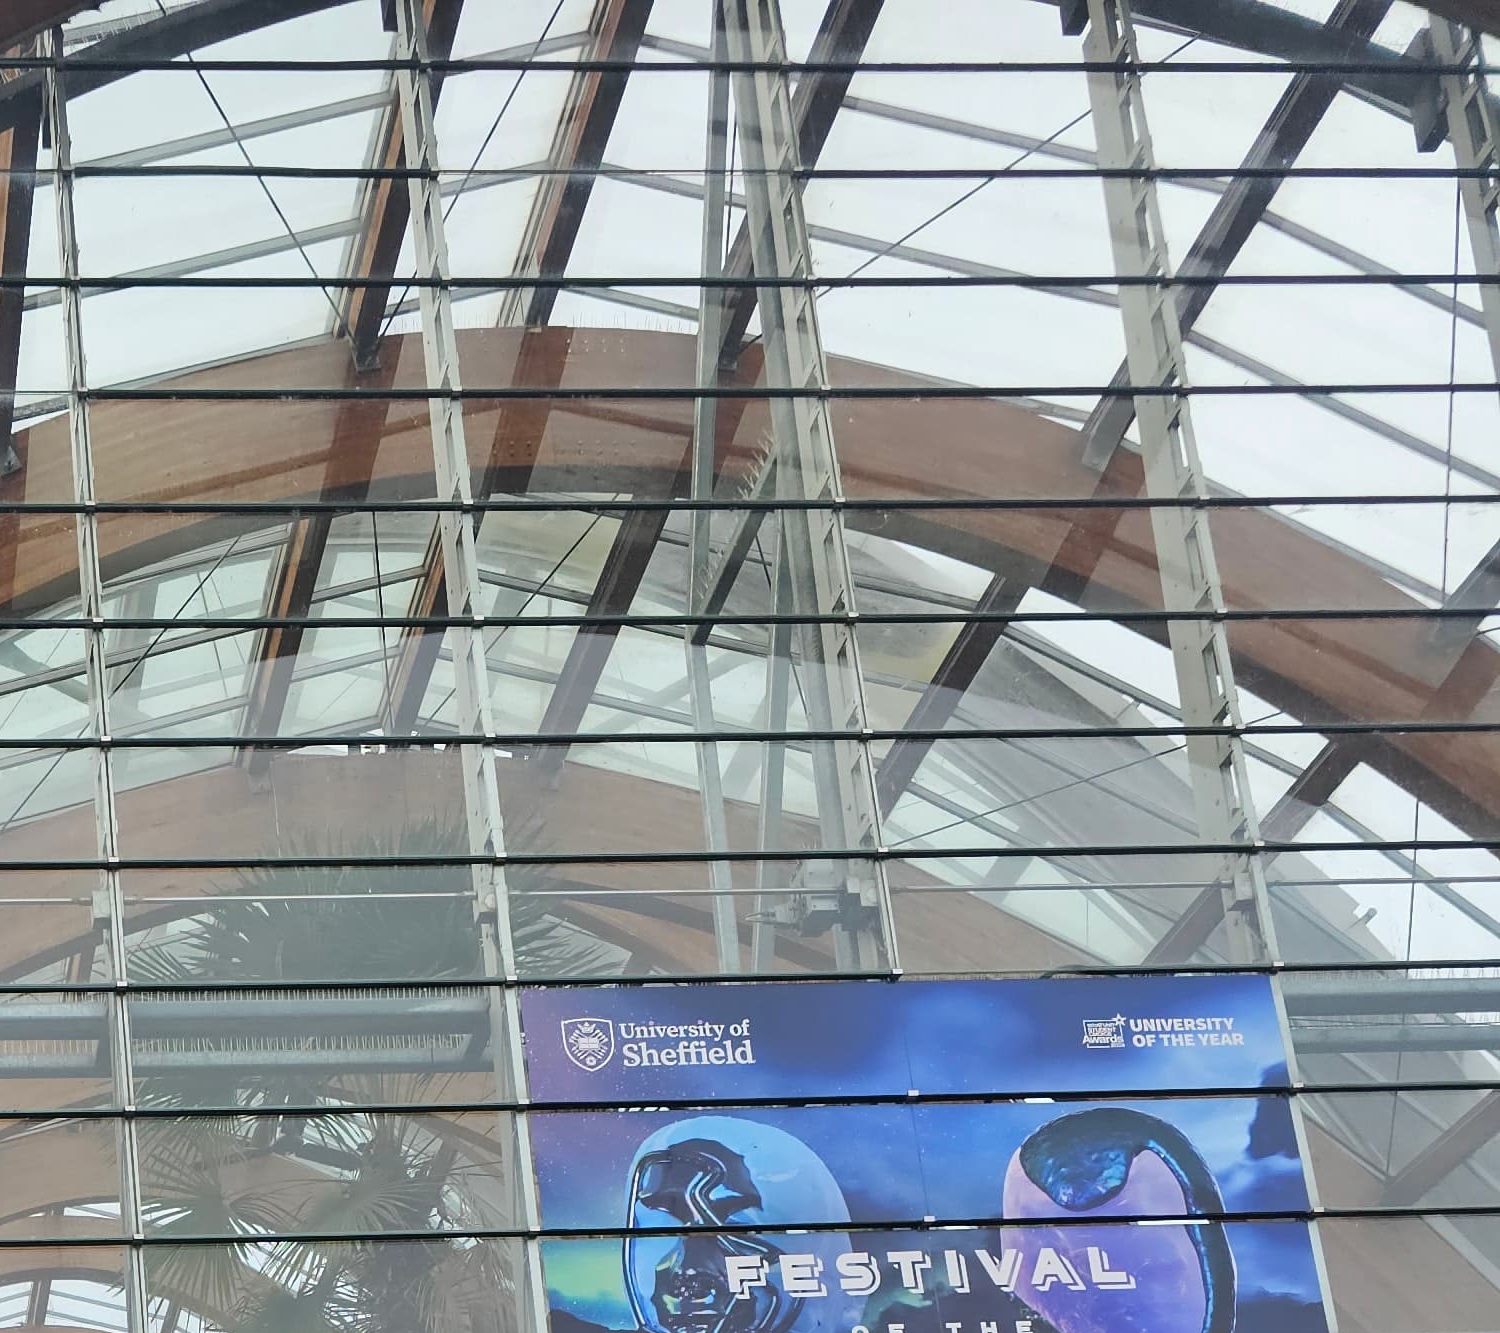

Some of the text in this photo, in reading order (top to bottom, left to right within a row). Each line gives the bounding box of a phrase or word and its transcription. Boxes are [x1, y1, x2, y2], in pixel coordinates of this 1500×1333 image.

[618, 1019, 750, 1041] University of
[1129, 1017, 1234, 1032] UNIVERSITY
[1132, 1033, 1244, 1047] OF THE YEAR
[623, 1039, 756, 1067] Sheffield
[725, 1246, 1137, 1298] FESTIVAL
